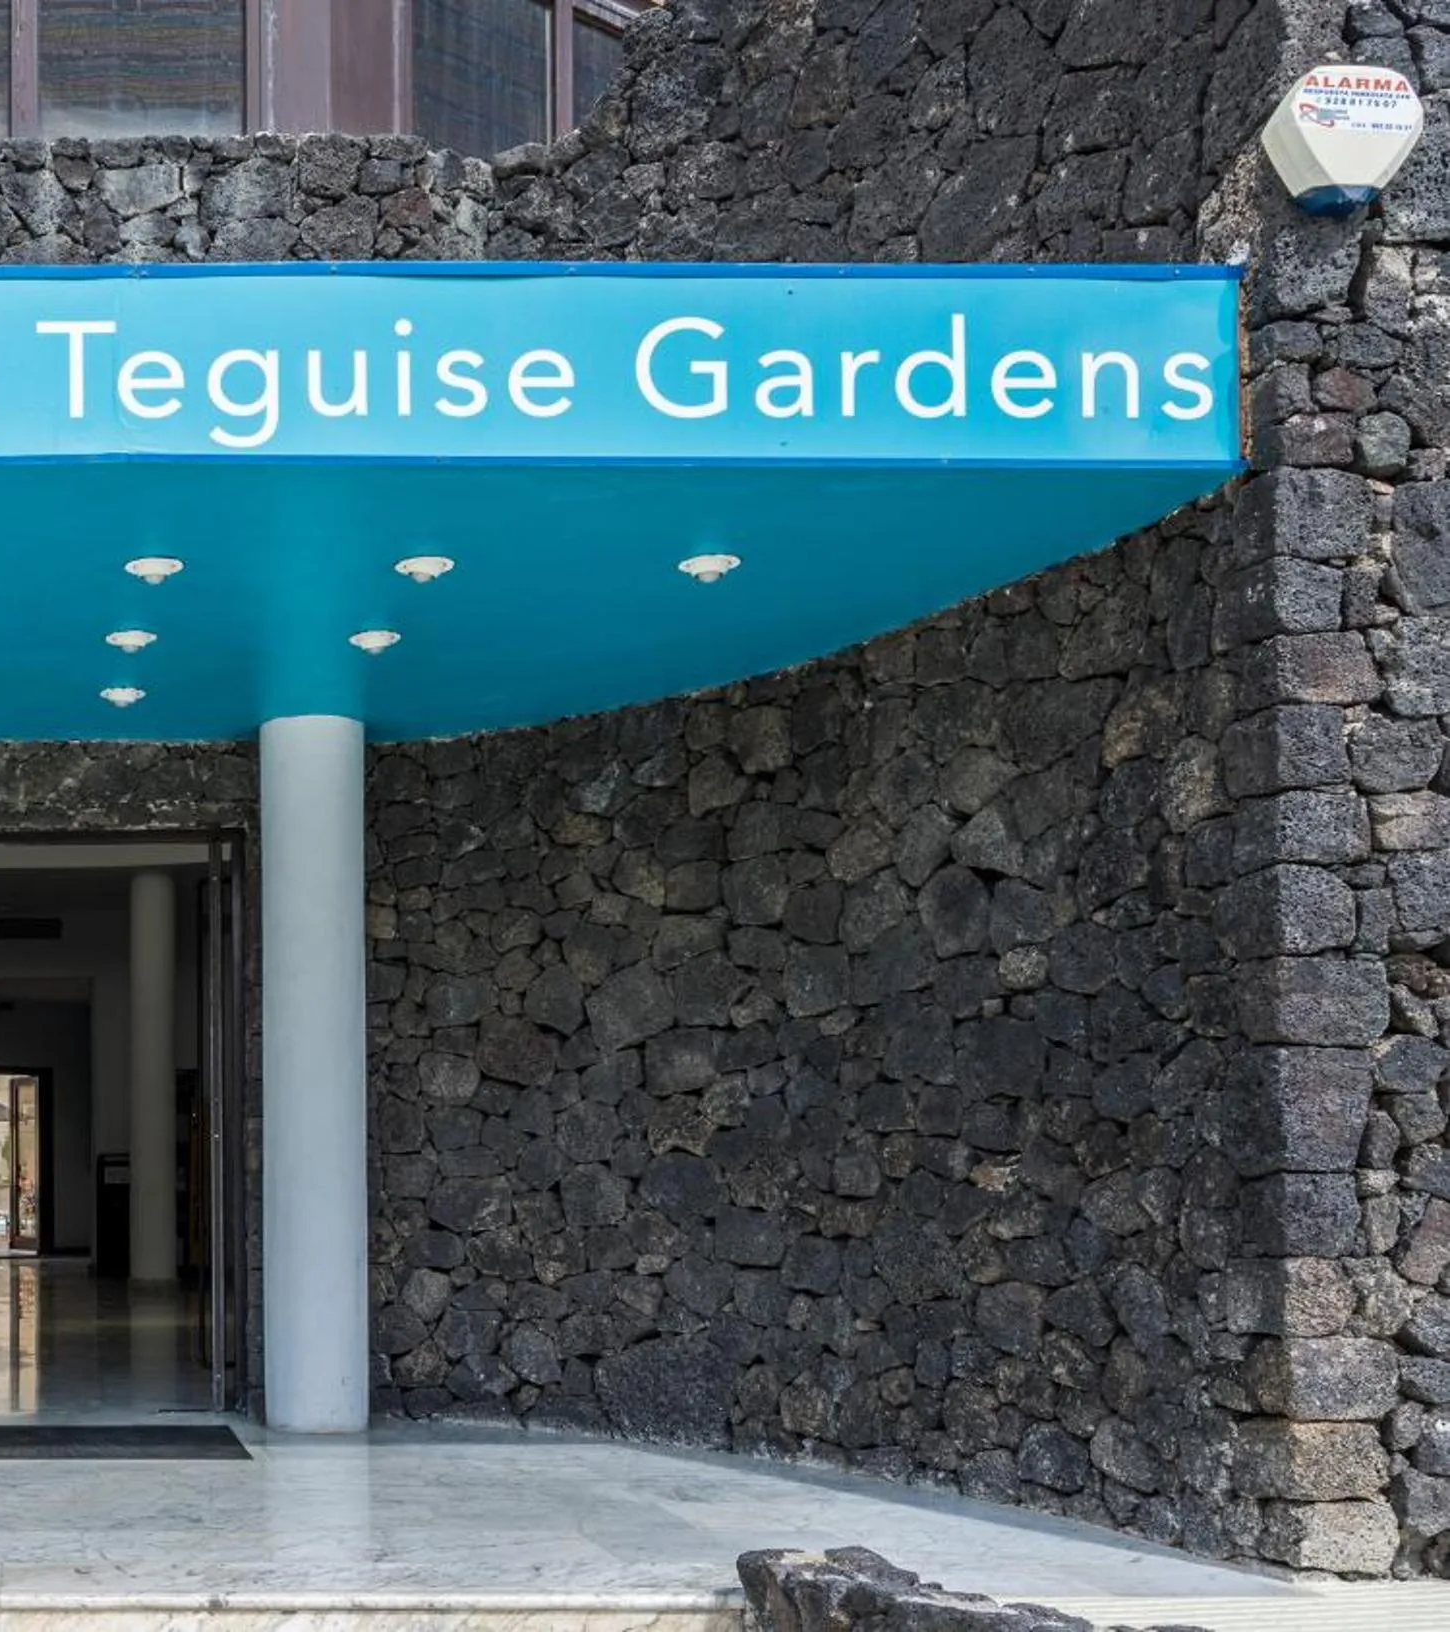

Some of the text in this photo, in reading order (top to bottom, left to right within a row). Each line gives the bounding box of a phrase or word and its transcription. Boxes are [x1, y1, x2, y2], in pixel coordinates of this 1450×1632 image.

[1305, 75, 1408, 91] ALARMA
[35, 318, 576, 449] Teguise
[635, 313, 1214, 420] Gardens
